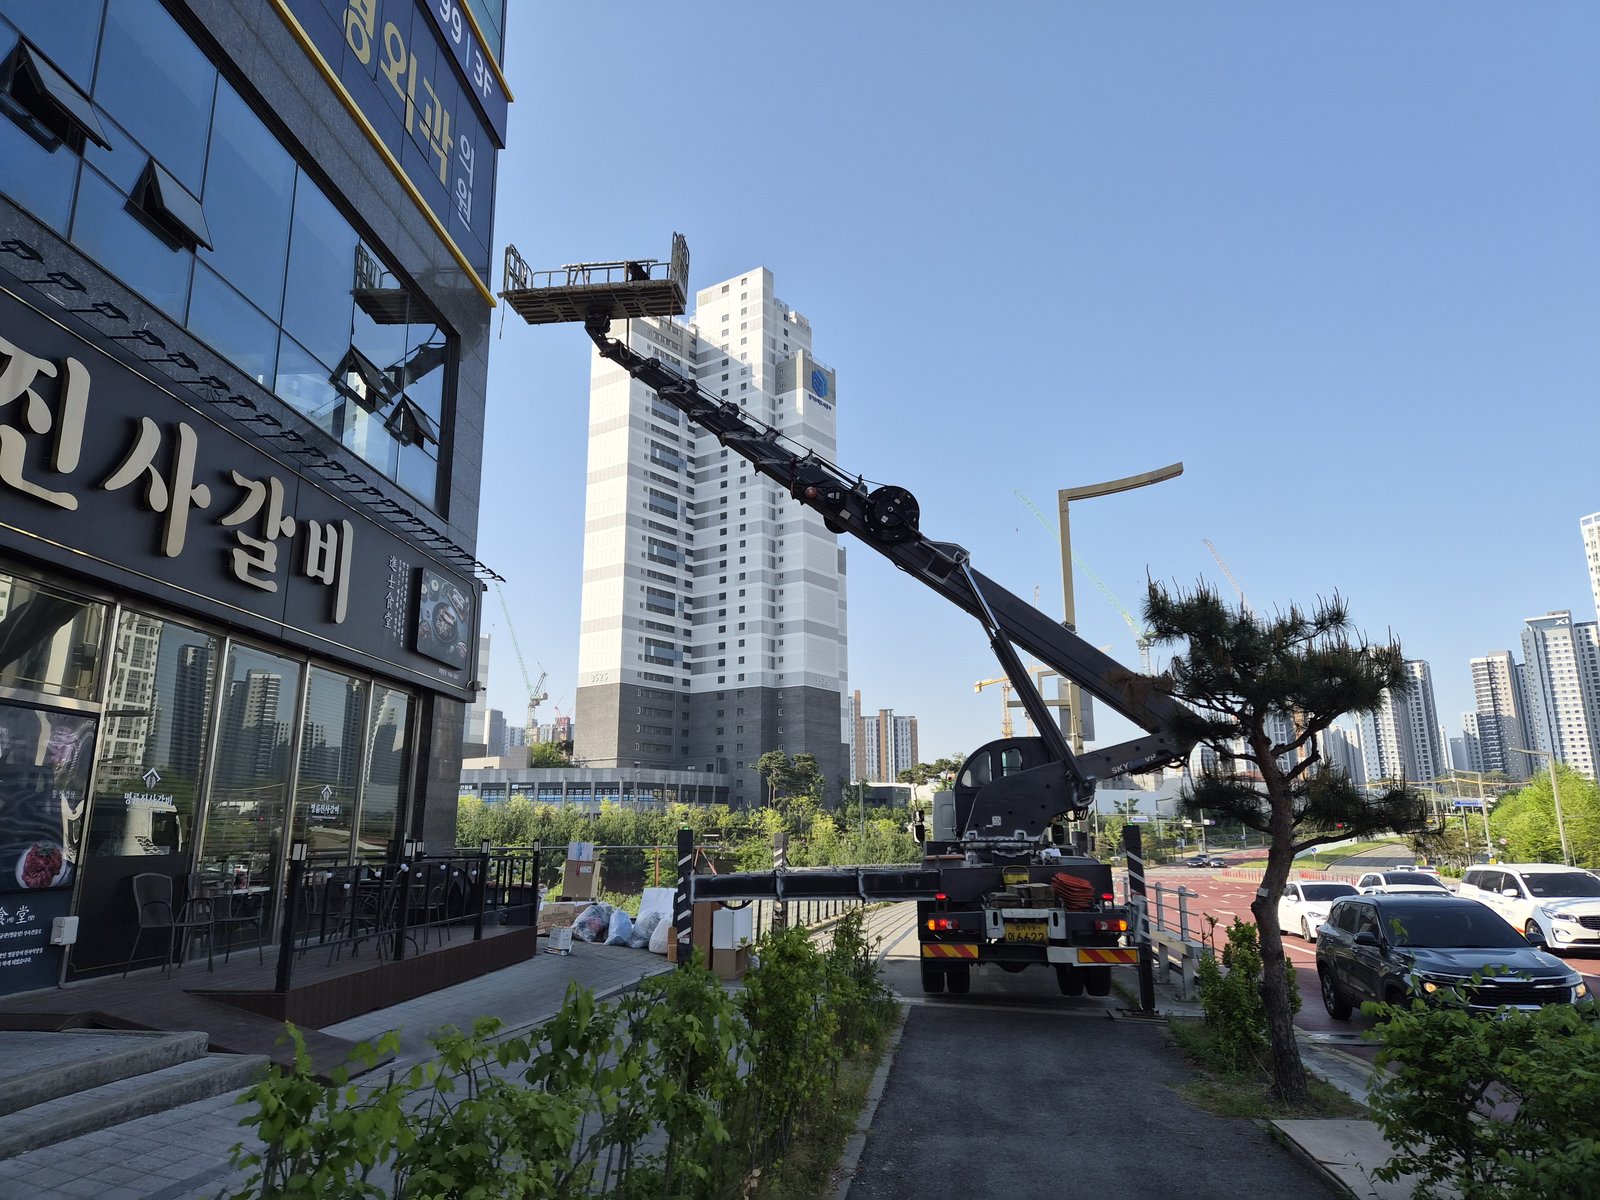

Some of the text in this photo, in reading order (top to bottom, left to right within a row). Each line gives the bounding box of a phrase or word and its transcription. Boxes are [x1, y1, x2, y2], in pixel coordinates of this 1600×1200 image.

[473, 50, 493, 98] 3F
[455, 134, 476, 233] 의원
[591, 672, 609, 683] 3525
[1111, 762, 1129, 774] SKY
